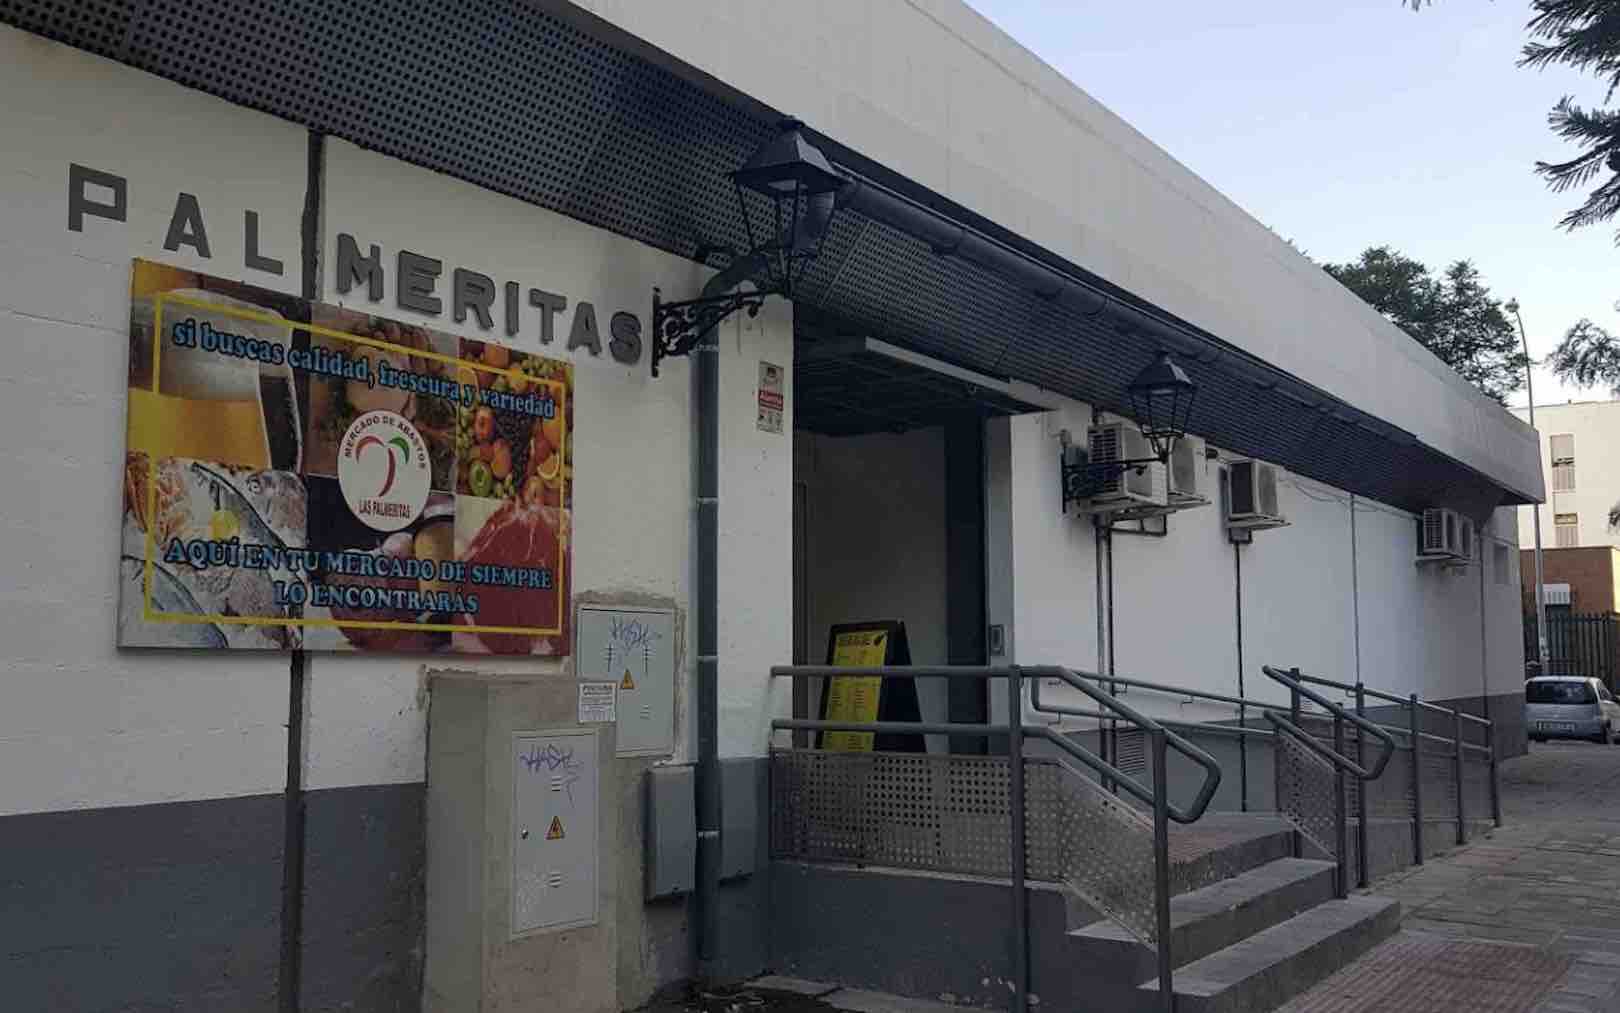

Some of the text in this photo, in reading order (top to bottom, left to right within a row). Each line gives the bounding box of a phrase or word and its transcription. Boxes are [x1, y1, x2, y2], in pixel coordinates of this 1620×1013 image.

[68, 162, 642, 365] PALMERITAS
[173, 318, 556, 420] si buscas calidad, frescura y variedad
[344, 415, 380, 458] MERCADO
[382, 415, 396, 426] DE
[359, 500, 371, 515] LAS
[164, 536, 552, 590] AQUÍ EN TU MERCADO DE SIEMPRE
[272, 580, 480, 614] LO ENCONTRARÁS
